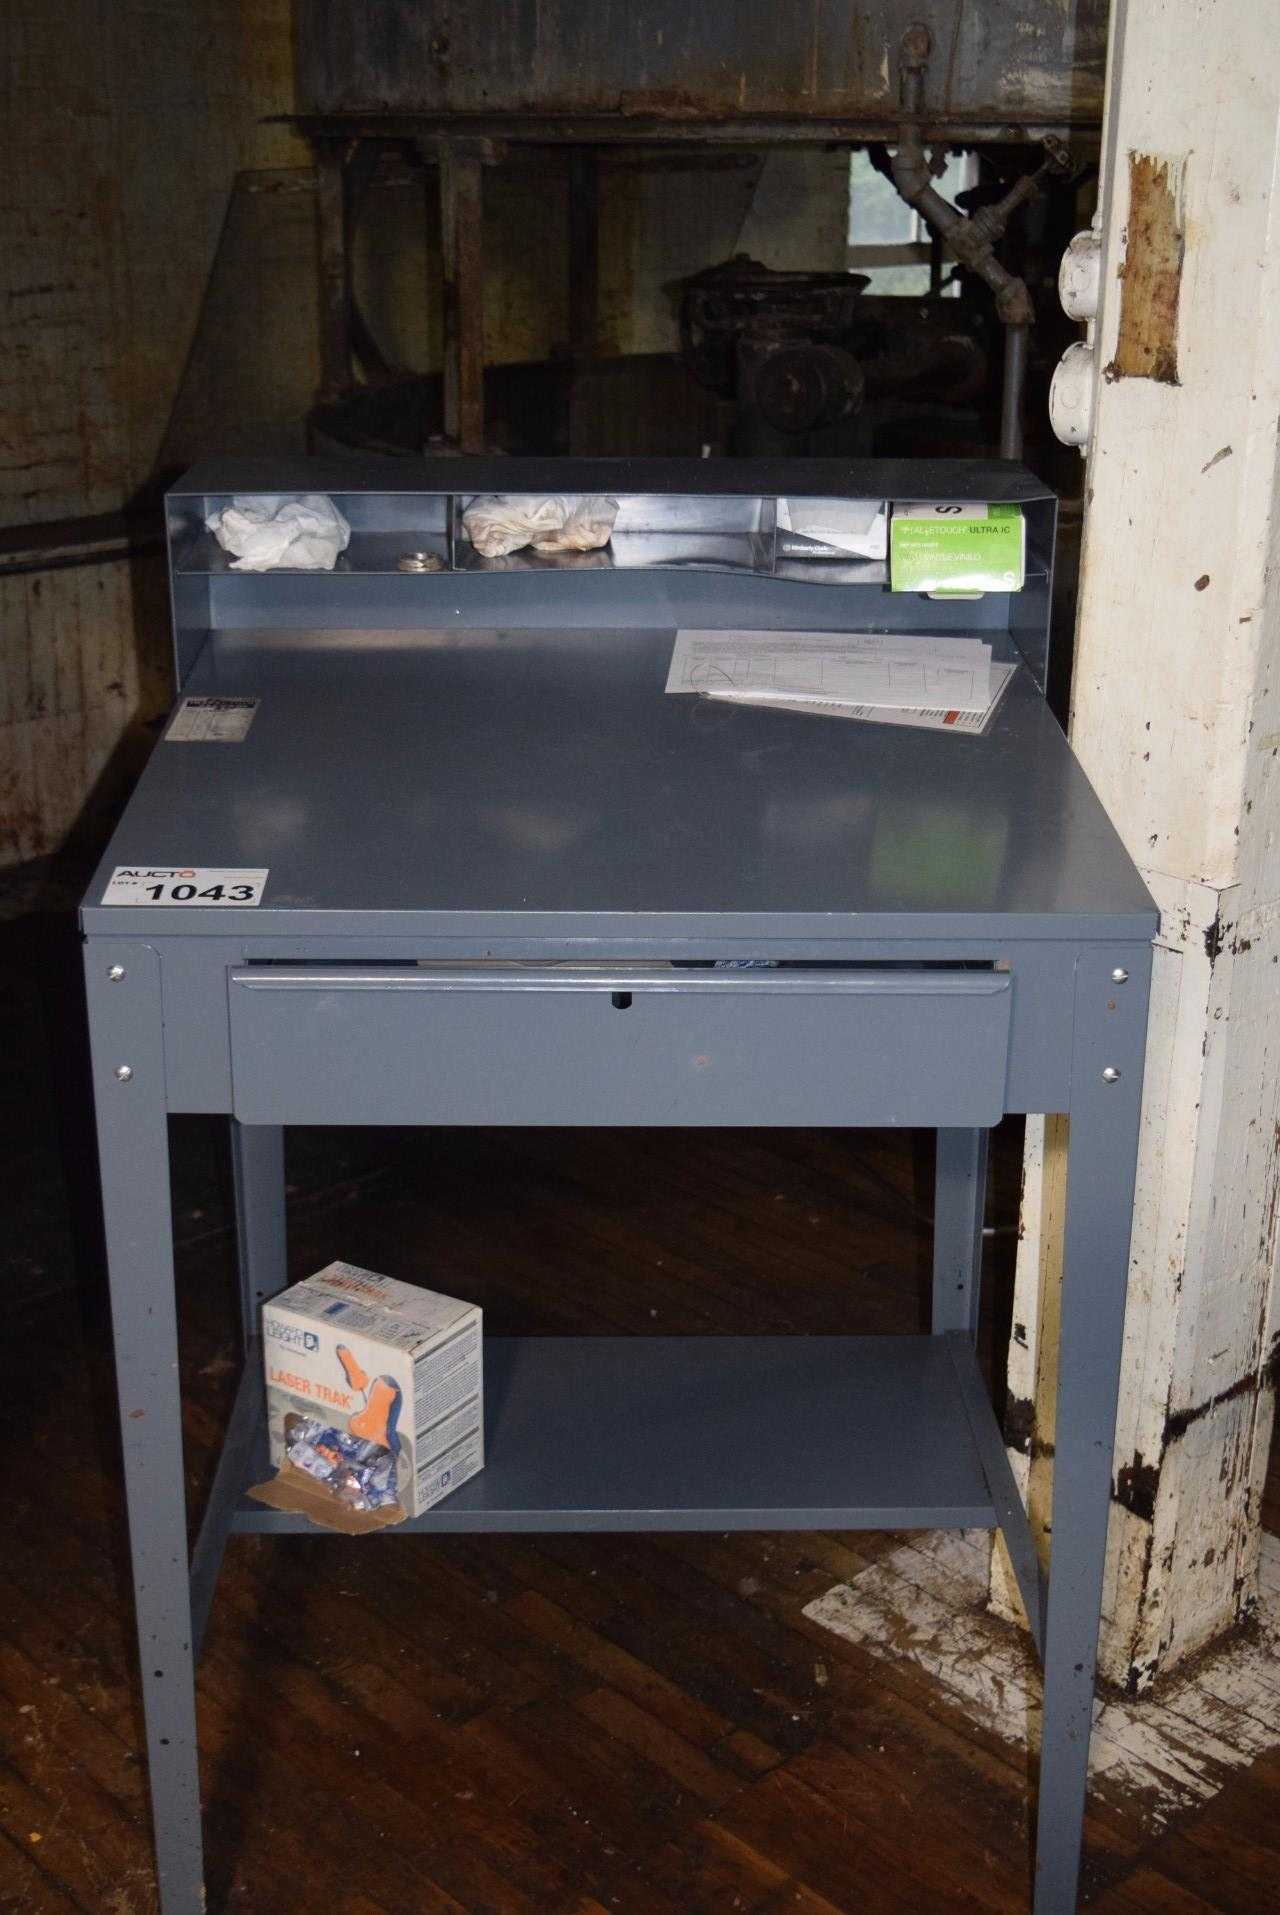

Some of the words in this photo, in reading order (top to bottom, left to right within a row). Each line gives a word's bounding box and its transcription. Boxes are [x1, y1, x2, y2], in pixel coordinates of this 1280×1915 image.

[935, 505, 963, 515] S
[969, 525, 999, 535] ULTRA
[1000, 525, 1011, 535] IC
[145, 884, 255, 901] 1043
[270, 1367, 311, 1394] LASER
[315, 1384, 353, 1409] TRAK
